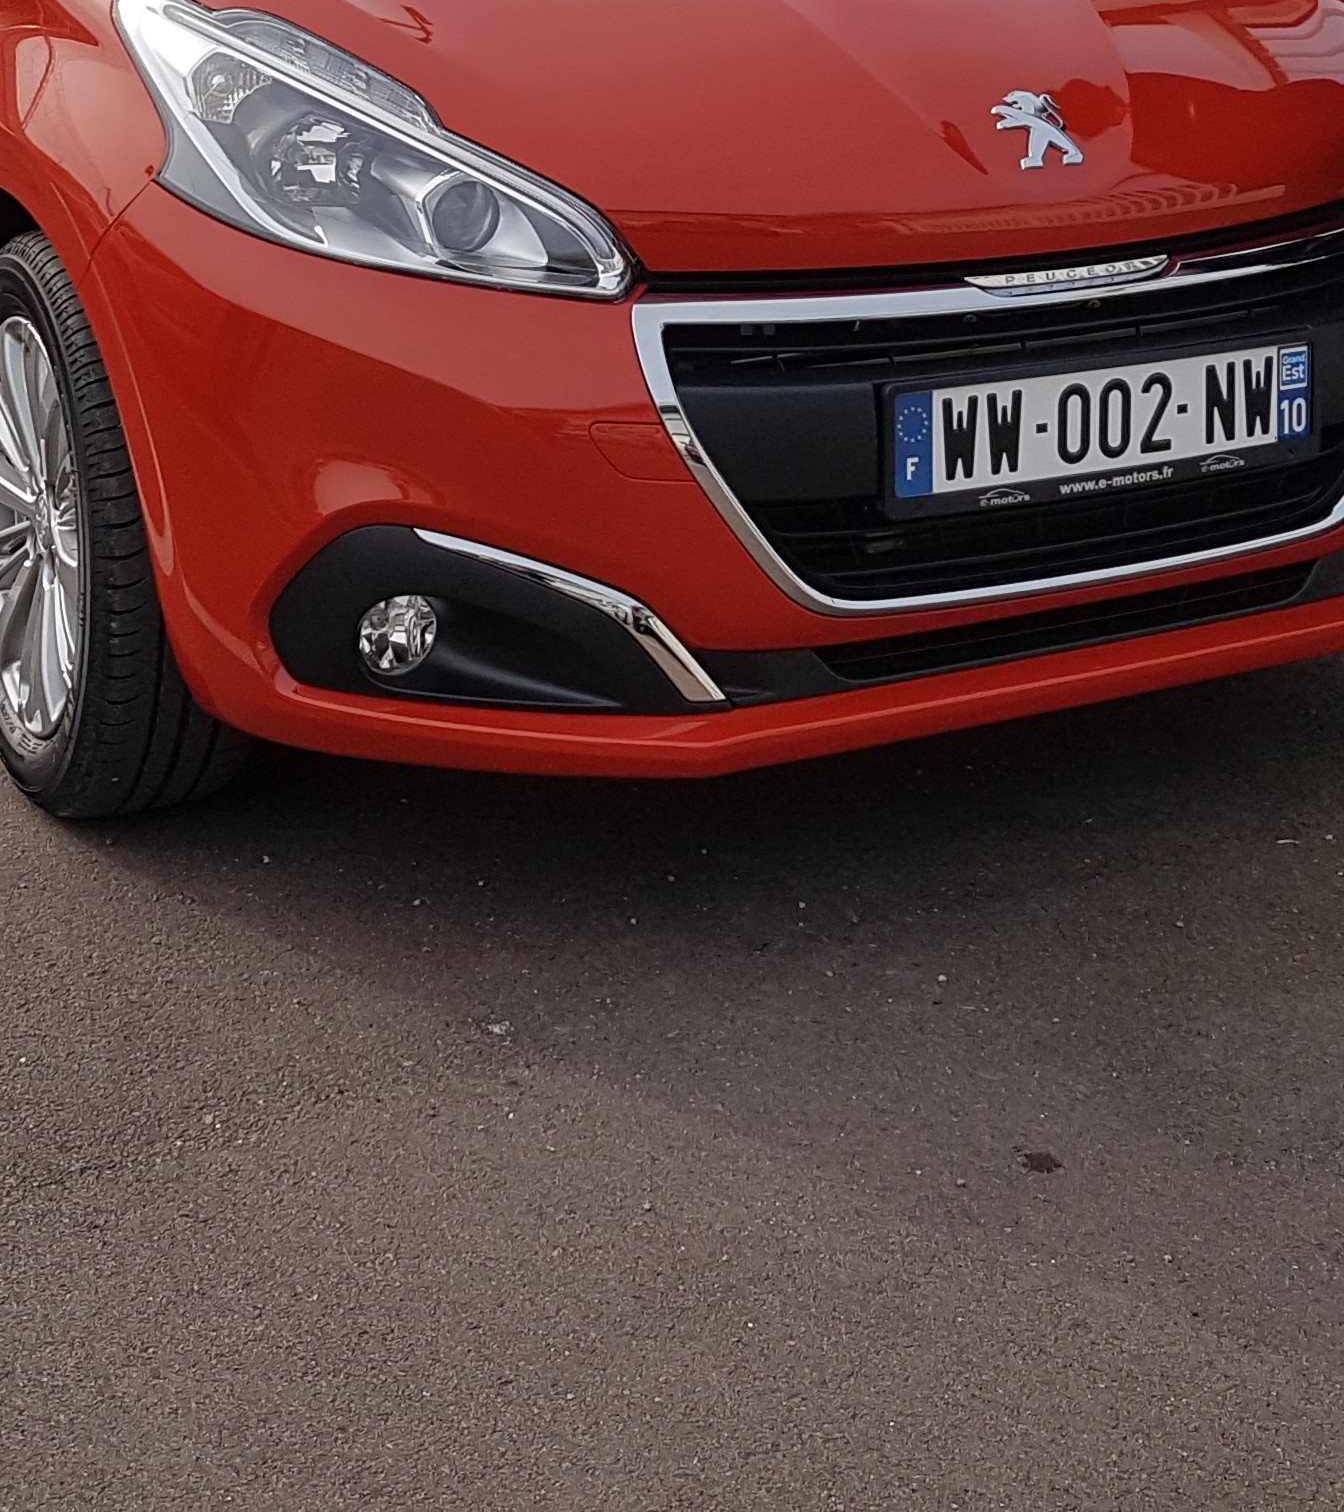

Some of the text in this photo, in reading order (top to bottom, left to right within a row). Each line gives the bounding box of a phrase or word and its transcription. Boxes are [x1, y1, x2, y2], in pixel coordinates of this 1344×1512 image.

[1282, 353, 1306, 365] Grand
[1282, 363, 1305, 381] Est
[941, 355, 1274, 481] WW-002-NW
[1280, 397, 1306, 435] 10
[907, 457, 919, 481] F
[1059, 466, 1174, 495] www.e-motors.fr
